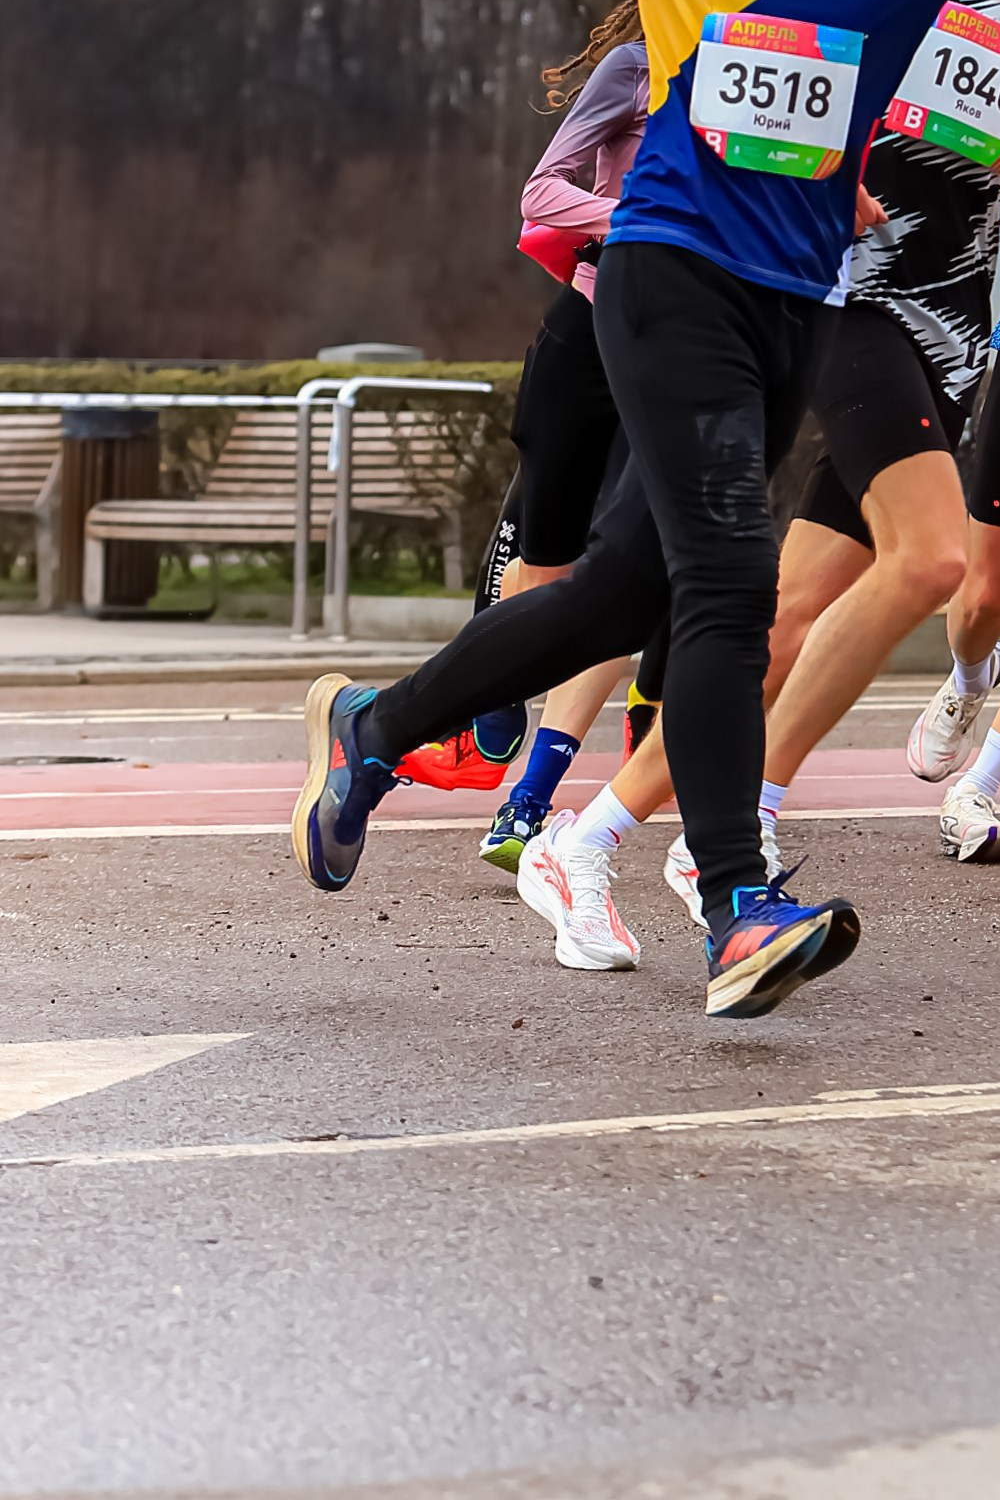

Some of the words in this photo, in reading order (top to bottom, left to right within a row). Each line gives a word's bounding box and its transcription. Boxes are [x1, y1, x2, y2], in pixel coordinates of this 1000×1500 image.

[730, 19, 799, 42] АПРЕЛЬ
[944, 8, 999, 40] АПРЕЛЬ
[719, 62, 832, 118] 3518
[954, 99, 982, 119] Яков
[753, 114, 791, 130] Юрий
